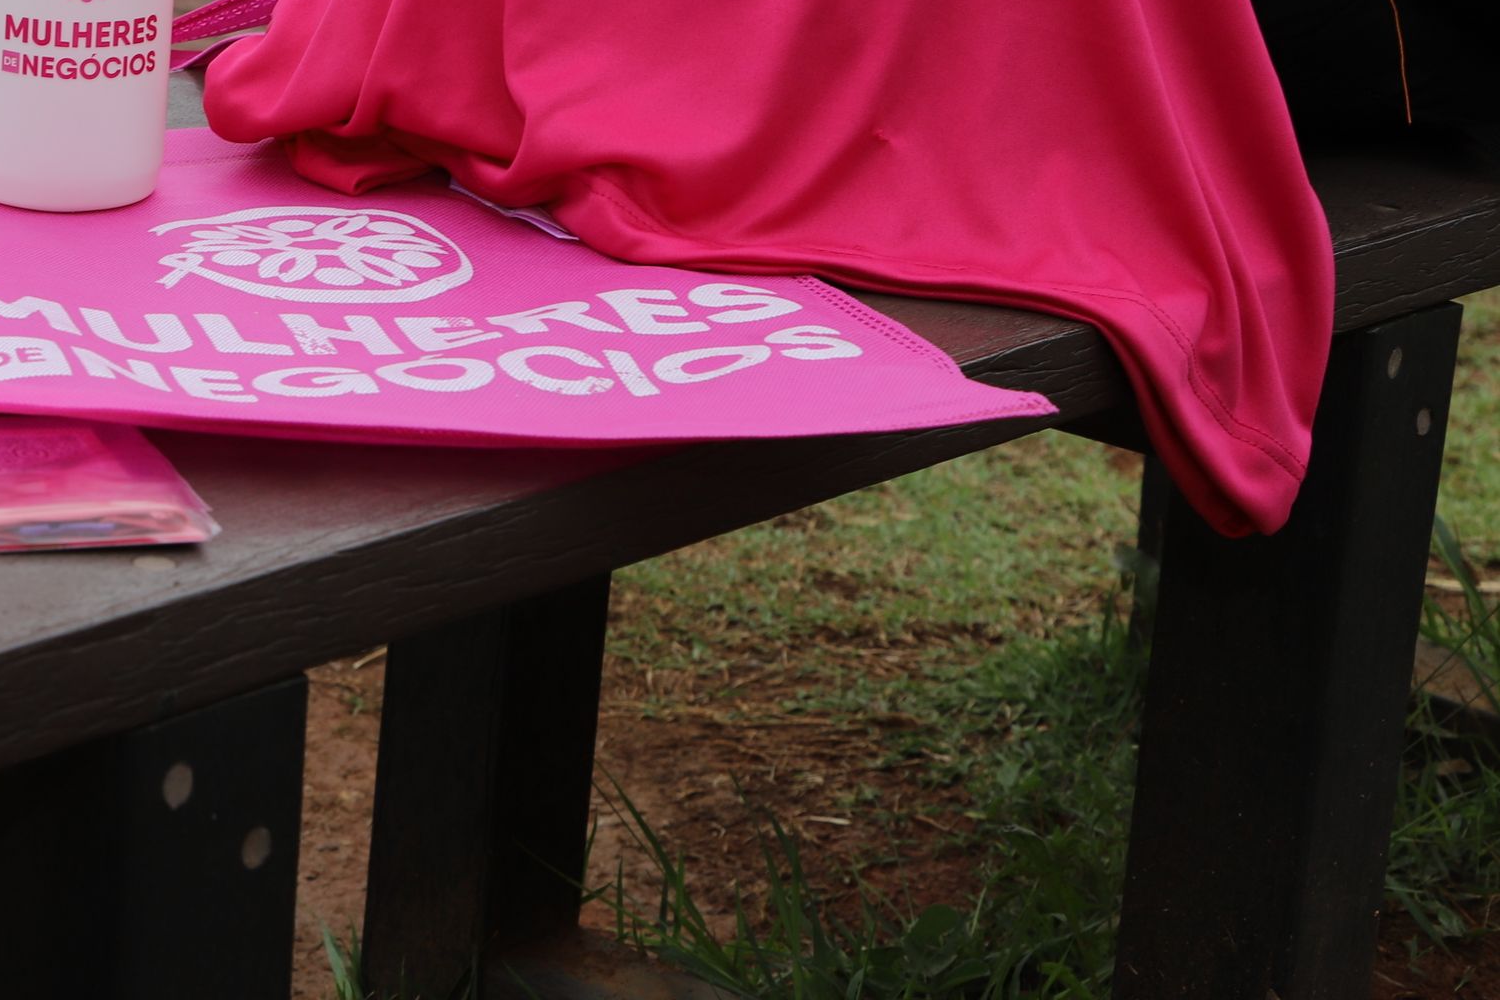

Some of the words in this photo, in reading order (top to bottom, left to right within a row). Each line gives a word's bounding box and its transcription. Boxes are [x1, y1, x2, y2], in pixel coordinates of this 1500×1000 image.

[3, 13, 159, 49] MULHERES
[21, 50, 157, 80] NEGÓCIOS
[70, 325, 864, 403] NEGÓCIOS
